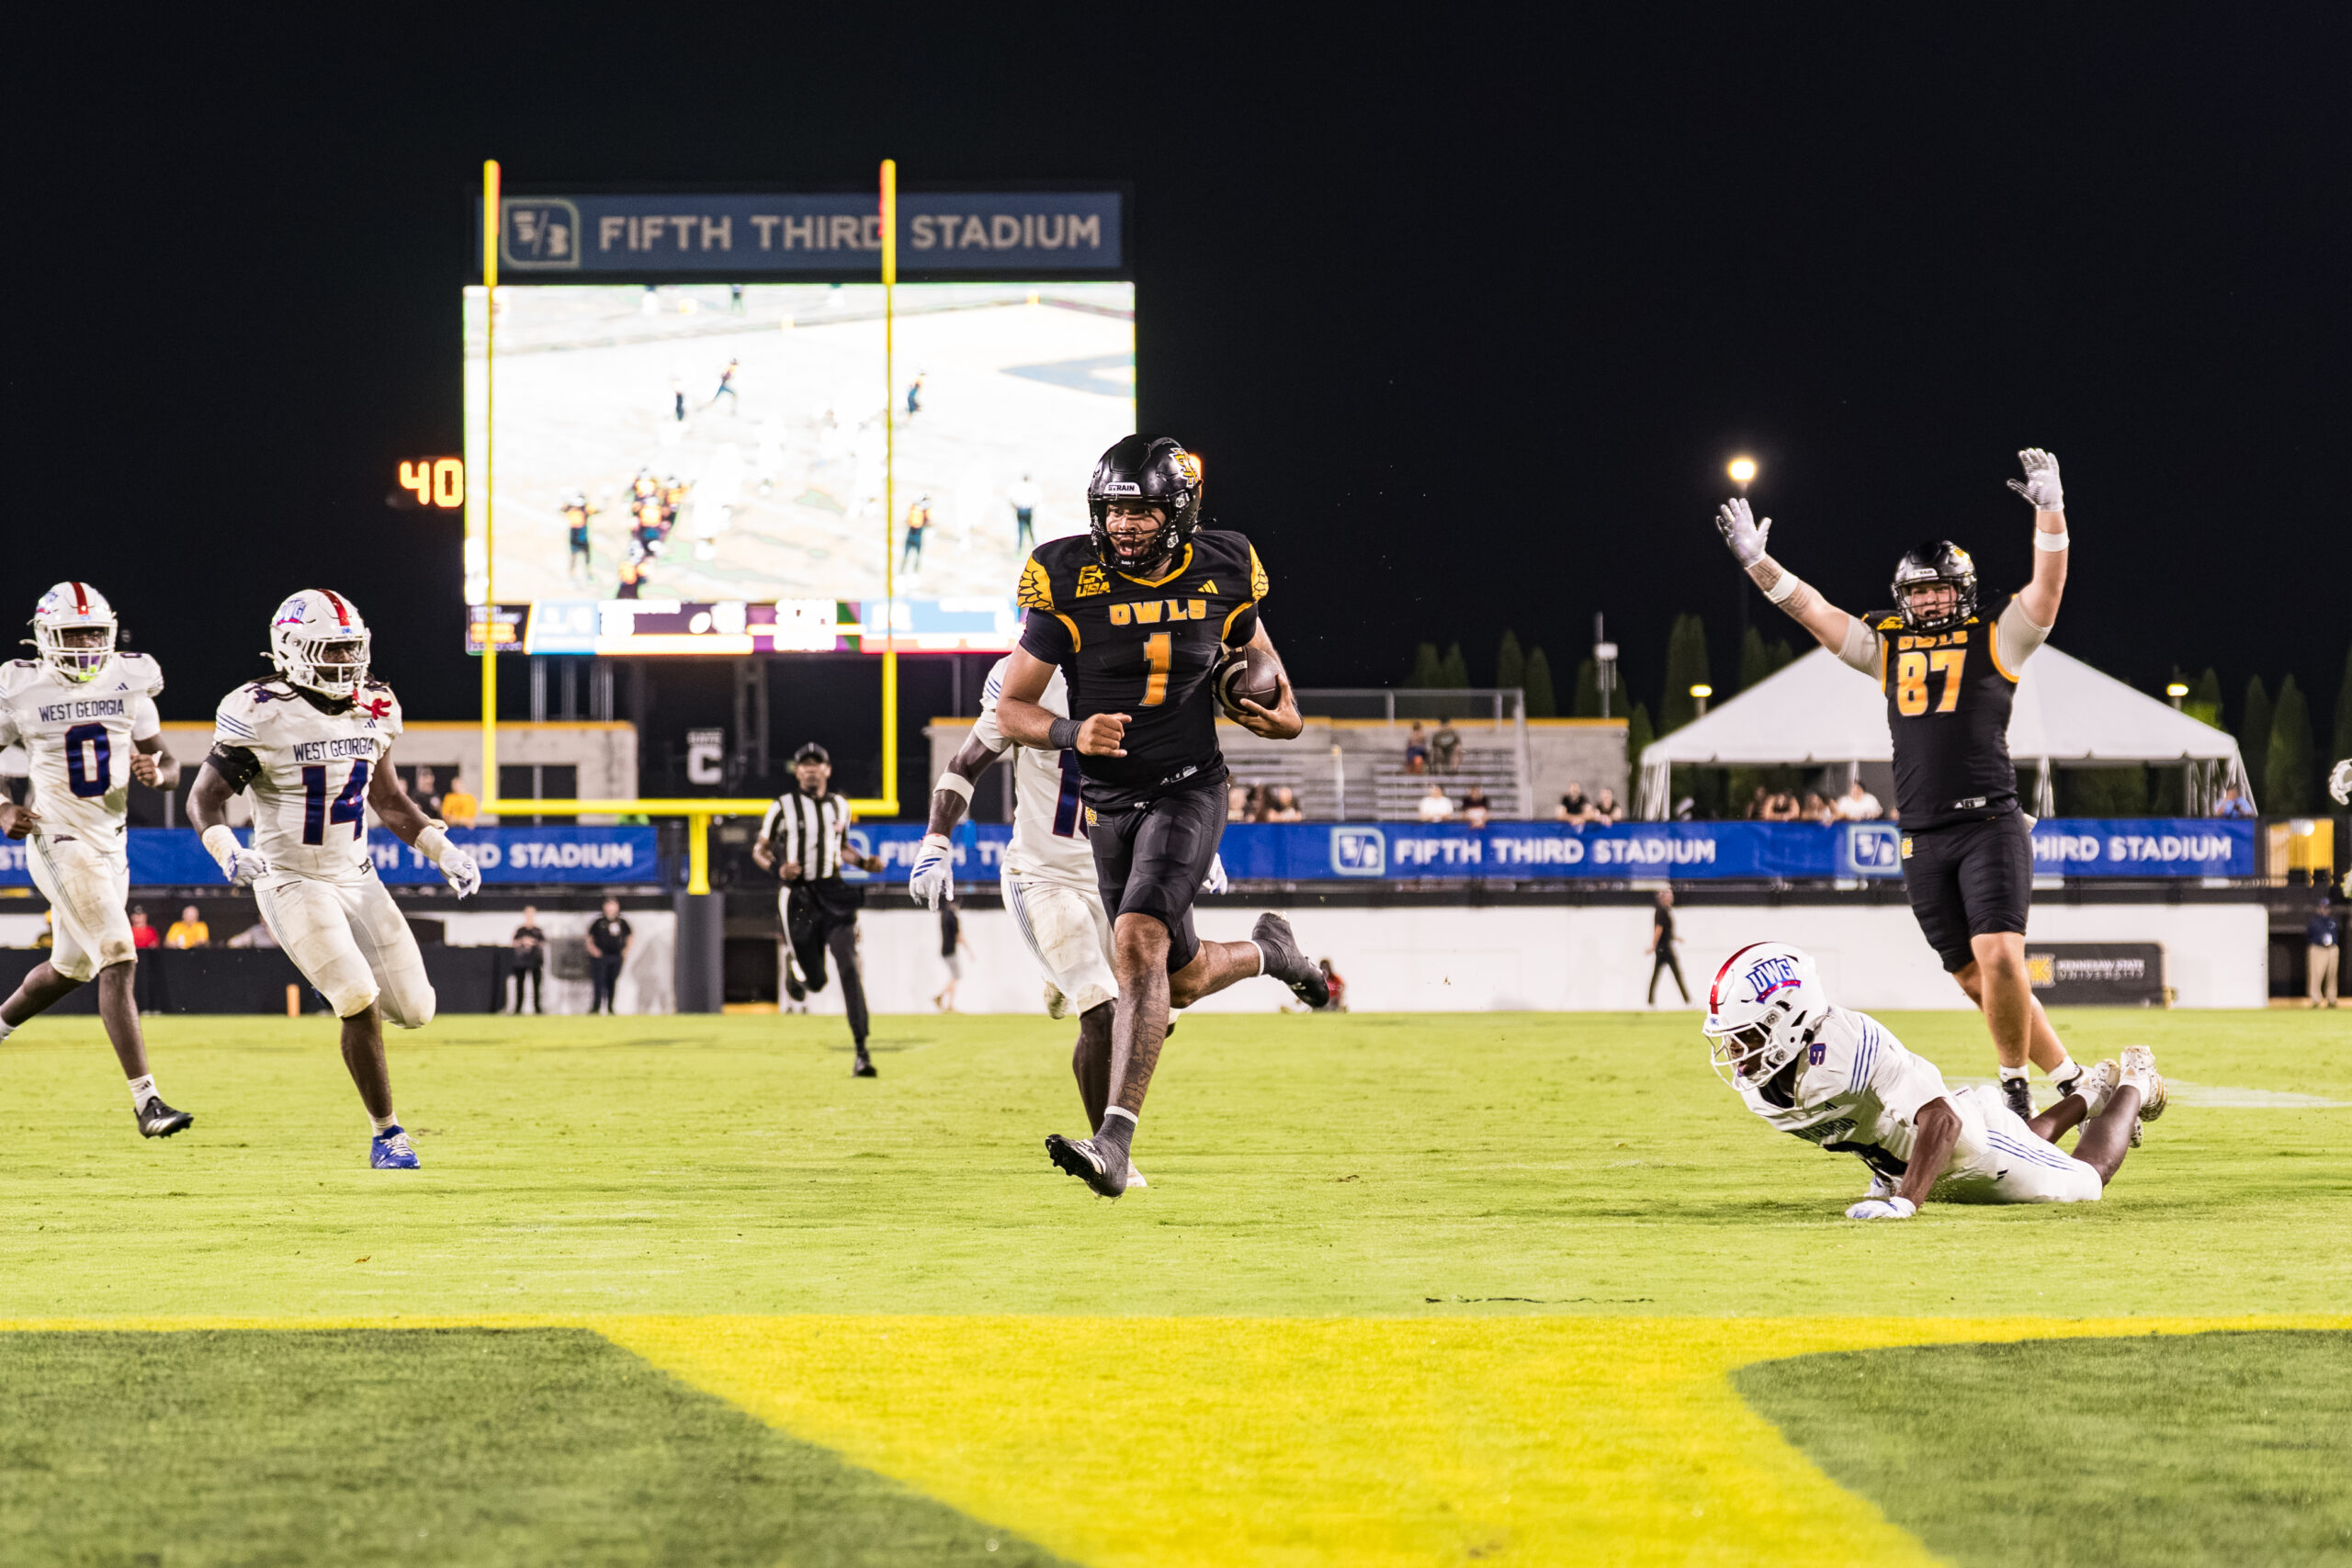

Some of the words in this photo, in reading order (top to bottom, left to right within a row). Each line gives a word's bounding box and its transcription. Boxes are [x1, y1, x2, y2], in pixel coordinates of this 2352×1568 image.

[598, 215, 732, 251] FIFTH
[910, 214, 1102, 250] STADIUM
[399, 457, 464, 508] 40
[1076, 581, 1111, 598] USA
[1109, 599, 1206, 626] OWLS
[1139, 632, 1171, 706] 1
[1897, 649, 1967, 716] 87
[39, 704, 72, 722] WEST
[75, 699, 125, 718] GEORGIA
[65, 722, 111, 798] 0
[293, 740, 327, 761] WEST
[331, 738, 374, 757] GEORGIA
[301, 758, 368, 846] 14
[509, 842, 634, 870] STADIUM
[1395, 839, 1482, 864] FIFTH
[1492, 838, 1585, 864] THIRD
[1592, 838, 1716, 864] STADIUM
[2032, 836, 2100, 862] HIRD
[2109, 836, 2233, 862] STADIUM
[1745, 958, 1797, 996] UWG
